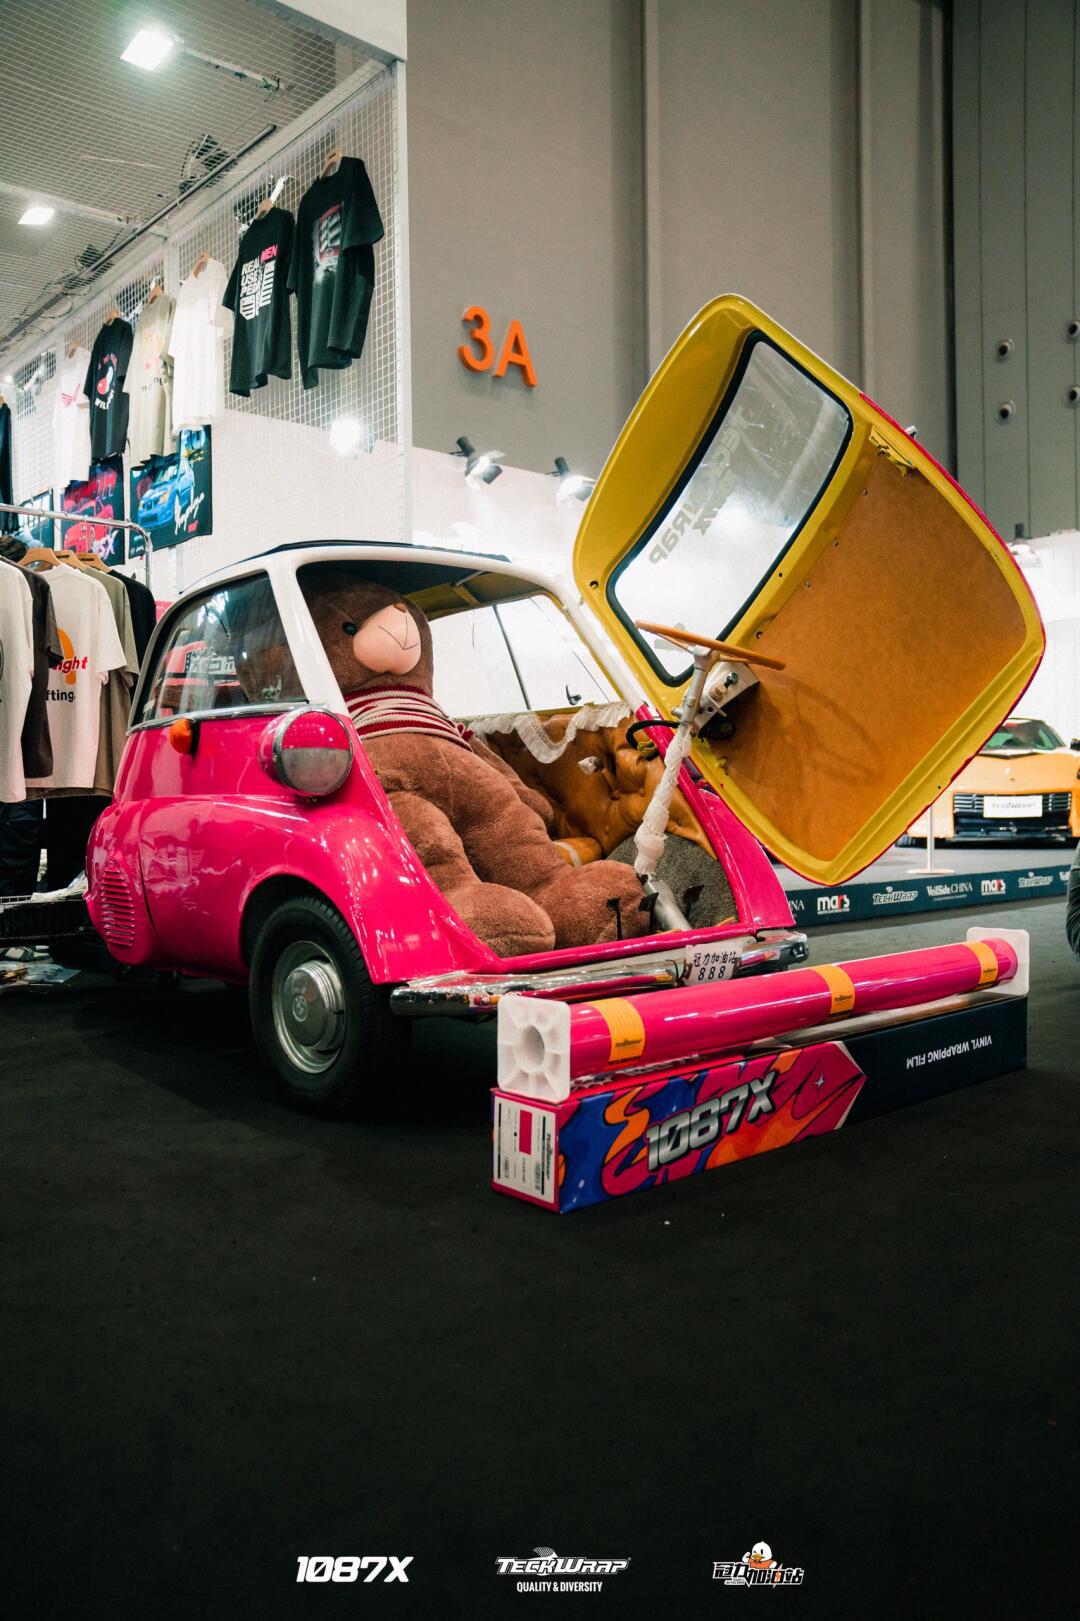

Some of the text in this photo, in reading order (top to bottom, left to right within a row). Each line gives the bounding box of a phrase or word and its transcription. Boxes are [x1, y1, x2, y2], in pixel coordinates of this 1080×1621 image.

[457, 305, 538, 388] 3A
[52, 656, 88, 674] ight
[816, 894, 850, 911] mars
[697, 965, 726, 981] 888
[906, 1034, 993, 1069] VINYL WRAPPING FILM
[646, 1070, 777, 1171] 1087X
